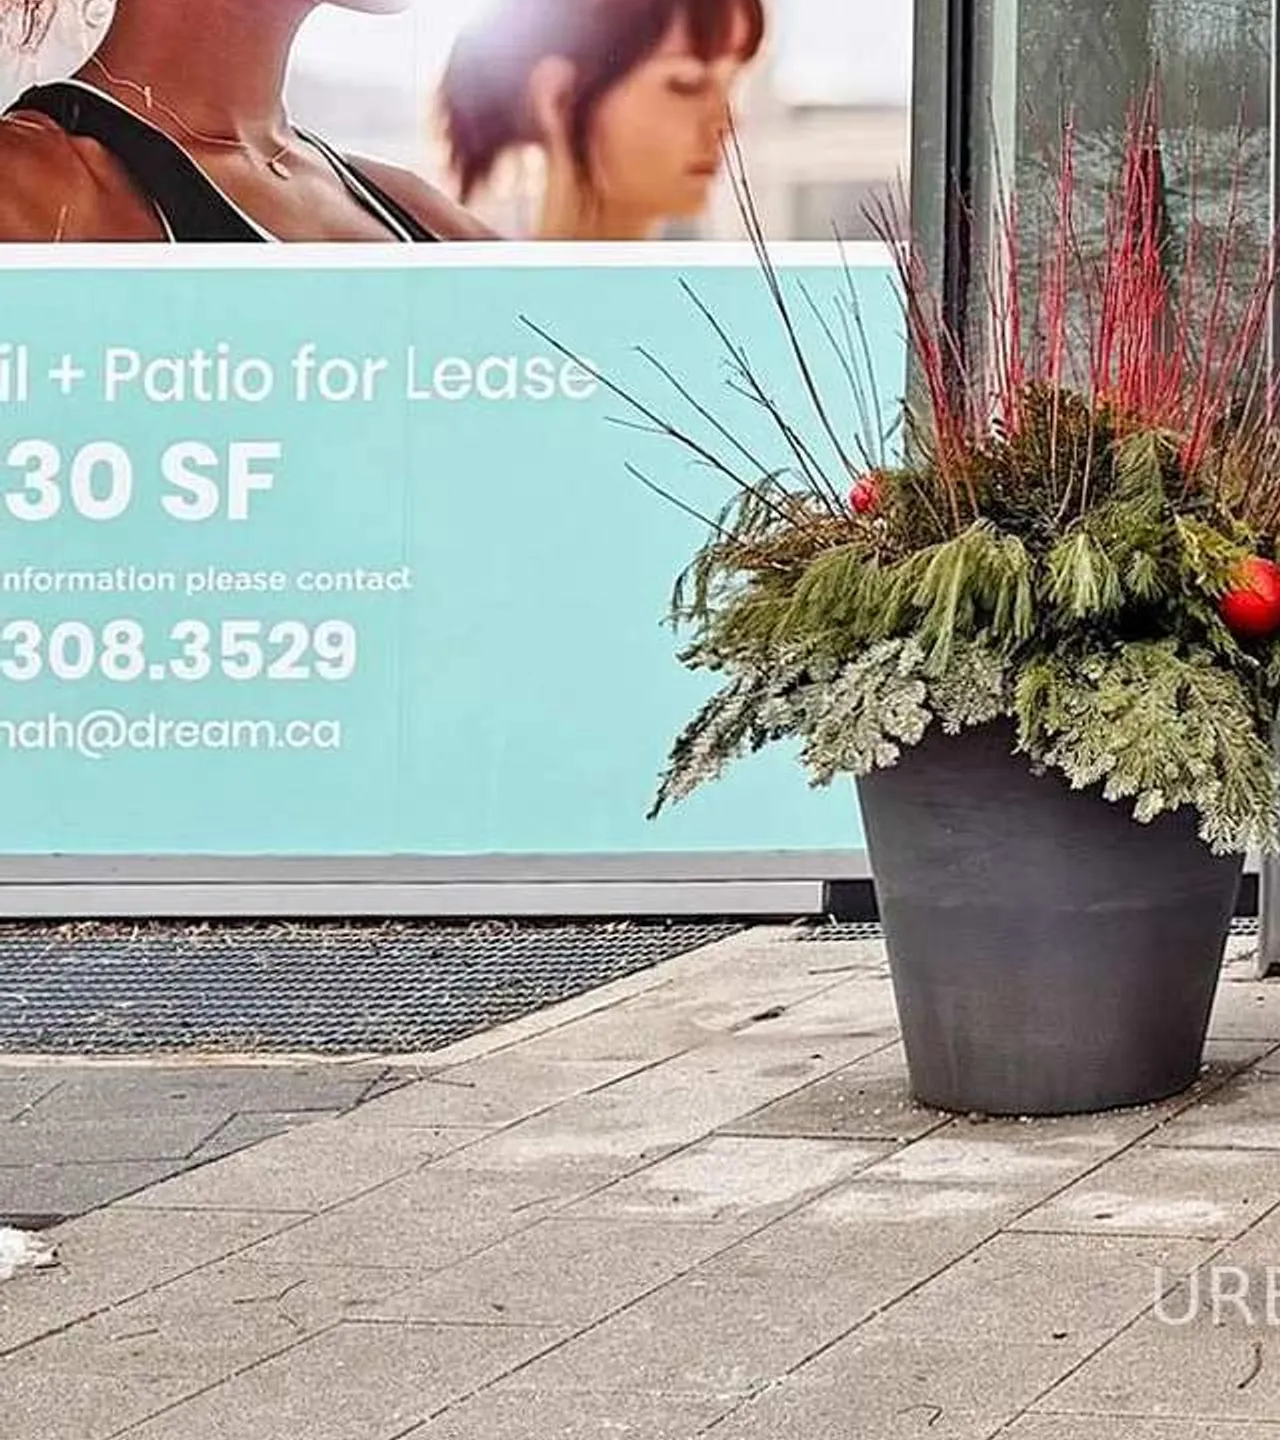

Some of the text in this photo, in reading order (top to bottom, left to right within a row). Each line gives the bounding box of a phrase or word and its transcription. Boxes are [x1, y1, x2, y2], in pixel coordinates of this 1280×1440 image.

[48, 354, 85, 394] +
[105, 342, 274, 402] Patio
[291, 343, 388, 401] for
[406, 346, 599, 401] Lease
[4, 438, 282, 521] 30 SF
[186, 566, 287, 597] please
[296, 566, 411, 593] contact
[0, 619, 357, 681] 308.3529
